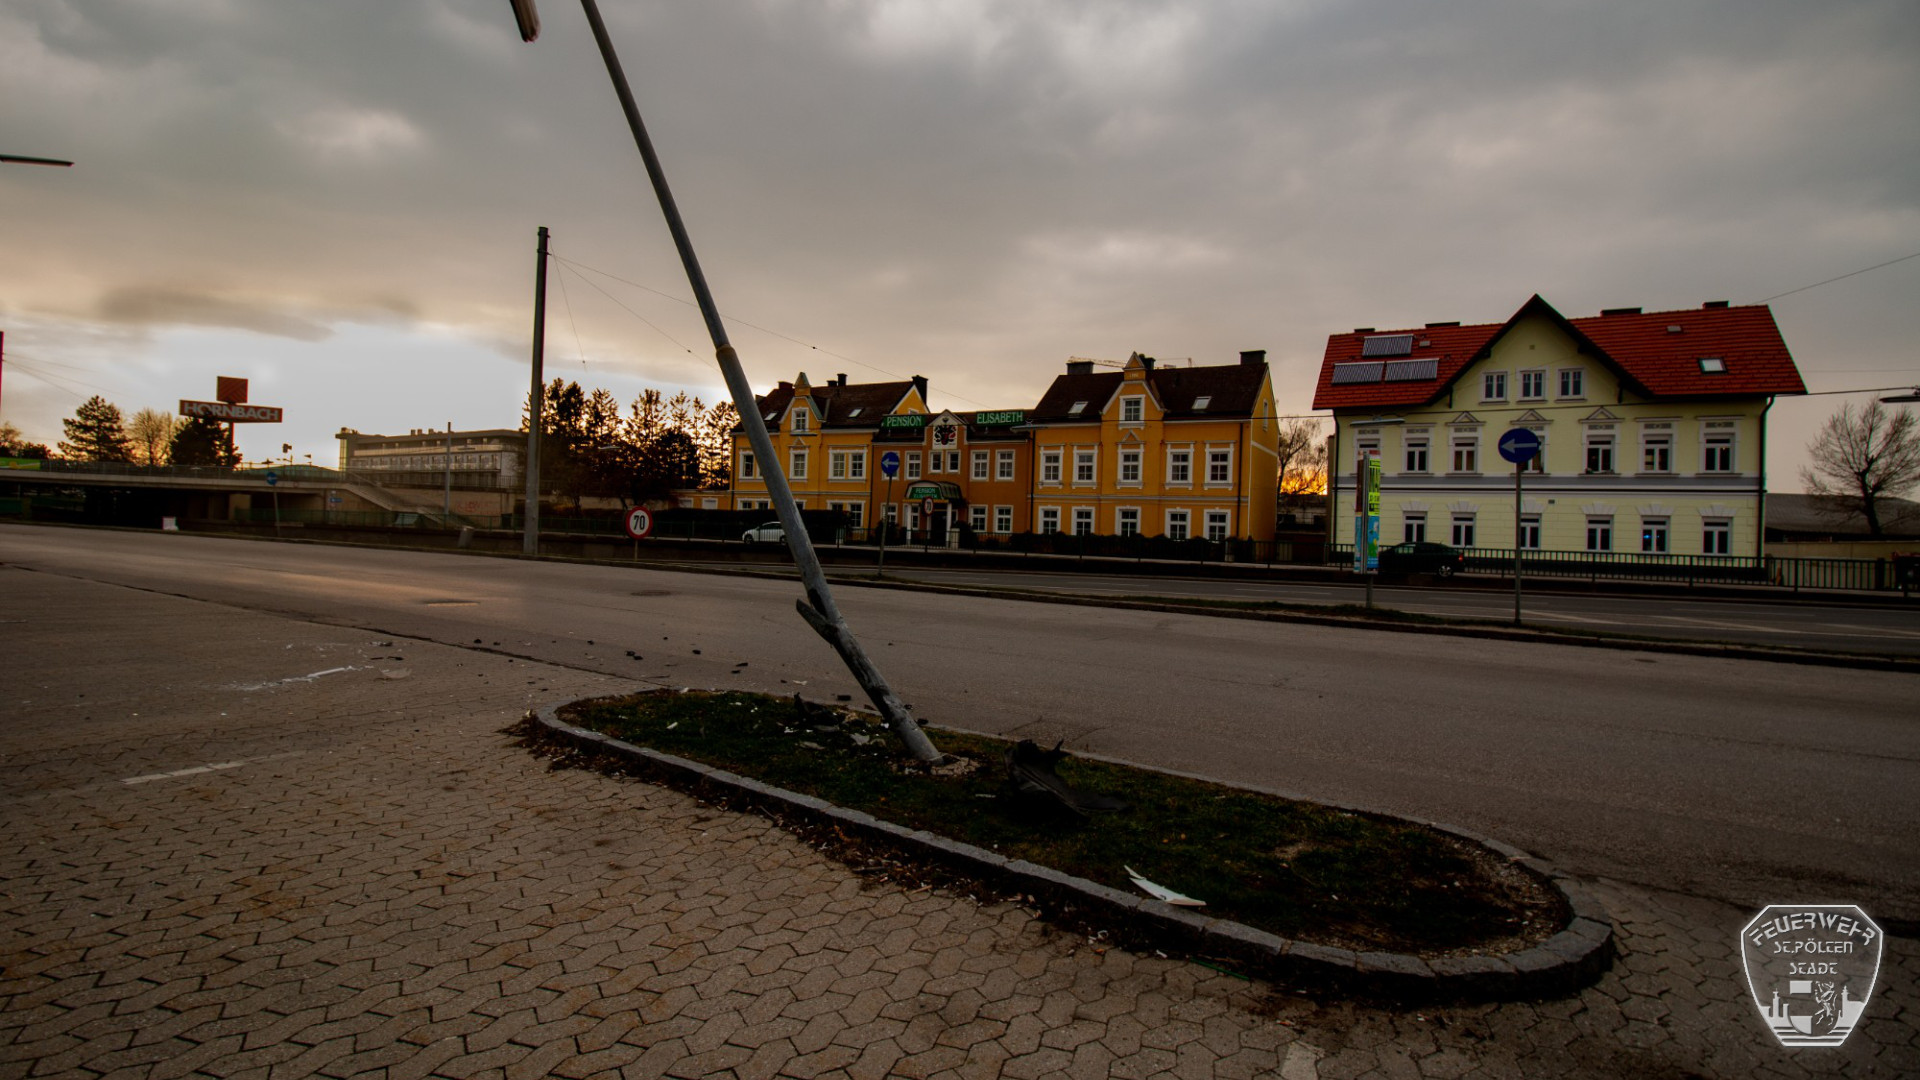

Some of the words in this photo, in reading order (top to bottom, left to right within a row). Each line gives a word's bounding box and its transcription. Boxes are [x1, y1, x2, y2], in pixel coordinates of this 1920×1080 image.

[183, 402, 278, 420] HORNBACH
[886, 415, 922, 427] PENSION
[976, 411, 1023, 424] ELISABETH
[634, 515, 645, 530] 70
